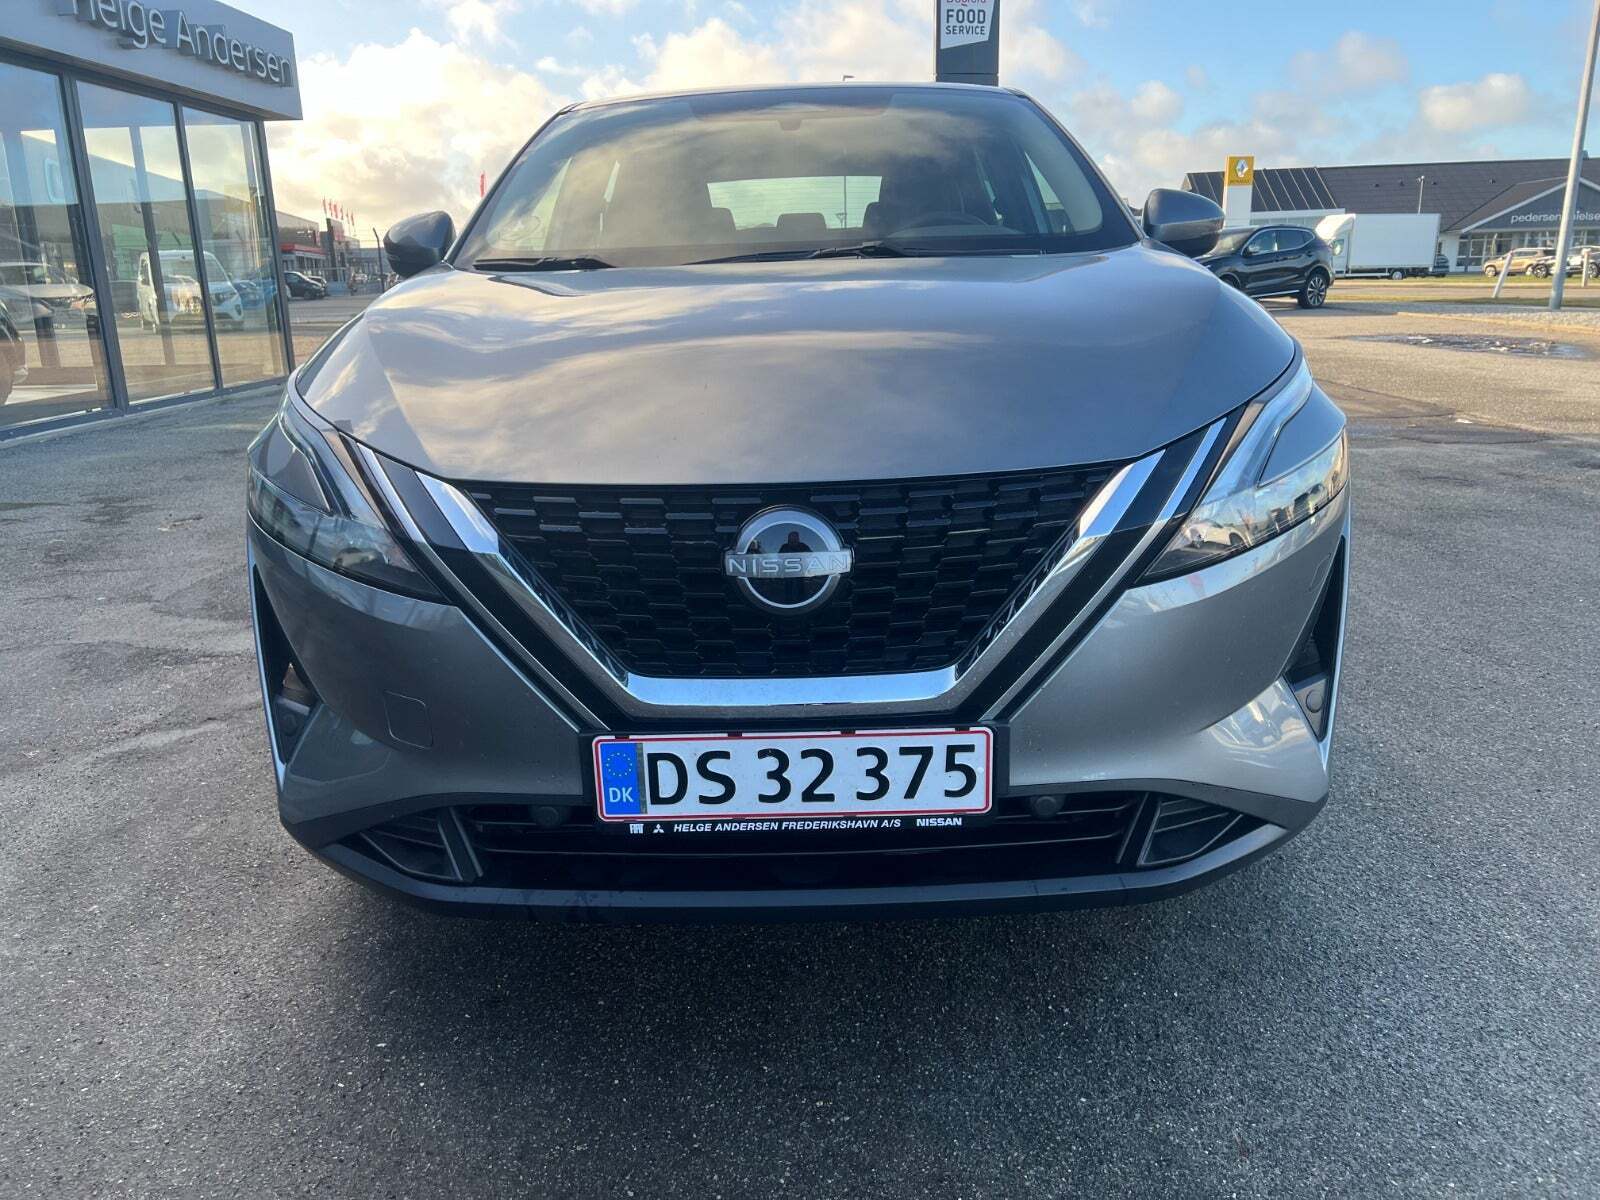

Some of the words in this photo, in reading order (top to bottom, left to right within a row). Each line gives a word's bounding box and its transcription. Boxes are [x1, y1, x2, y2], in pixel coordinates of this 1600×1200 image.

[946, 9, 986, 24] FOOD
[945, 25, 986, 35] SERVICE
[176, 11, 293, 85] Andersen
[728, 553, 849, 574] NISSAN
[646, 750, 737, 806] DS
[757, 748, 836, 804] 32
[856, 743, 978, 801] 375
[609, 786, 634, 803] DK
[673, 823, 712, 833] HELGE
[714, 821, 779, 832] ANDERSEN
[781, 819, 879, 831] FREDERIKSHAVN
[880, 818, 902, 829] A/S
[916, 817, 962, 827] NISSAN
